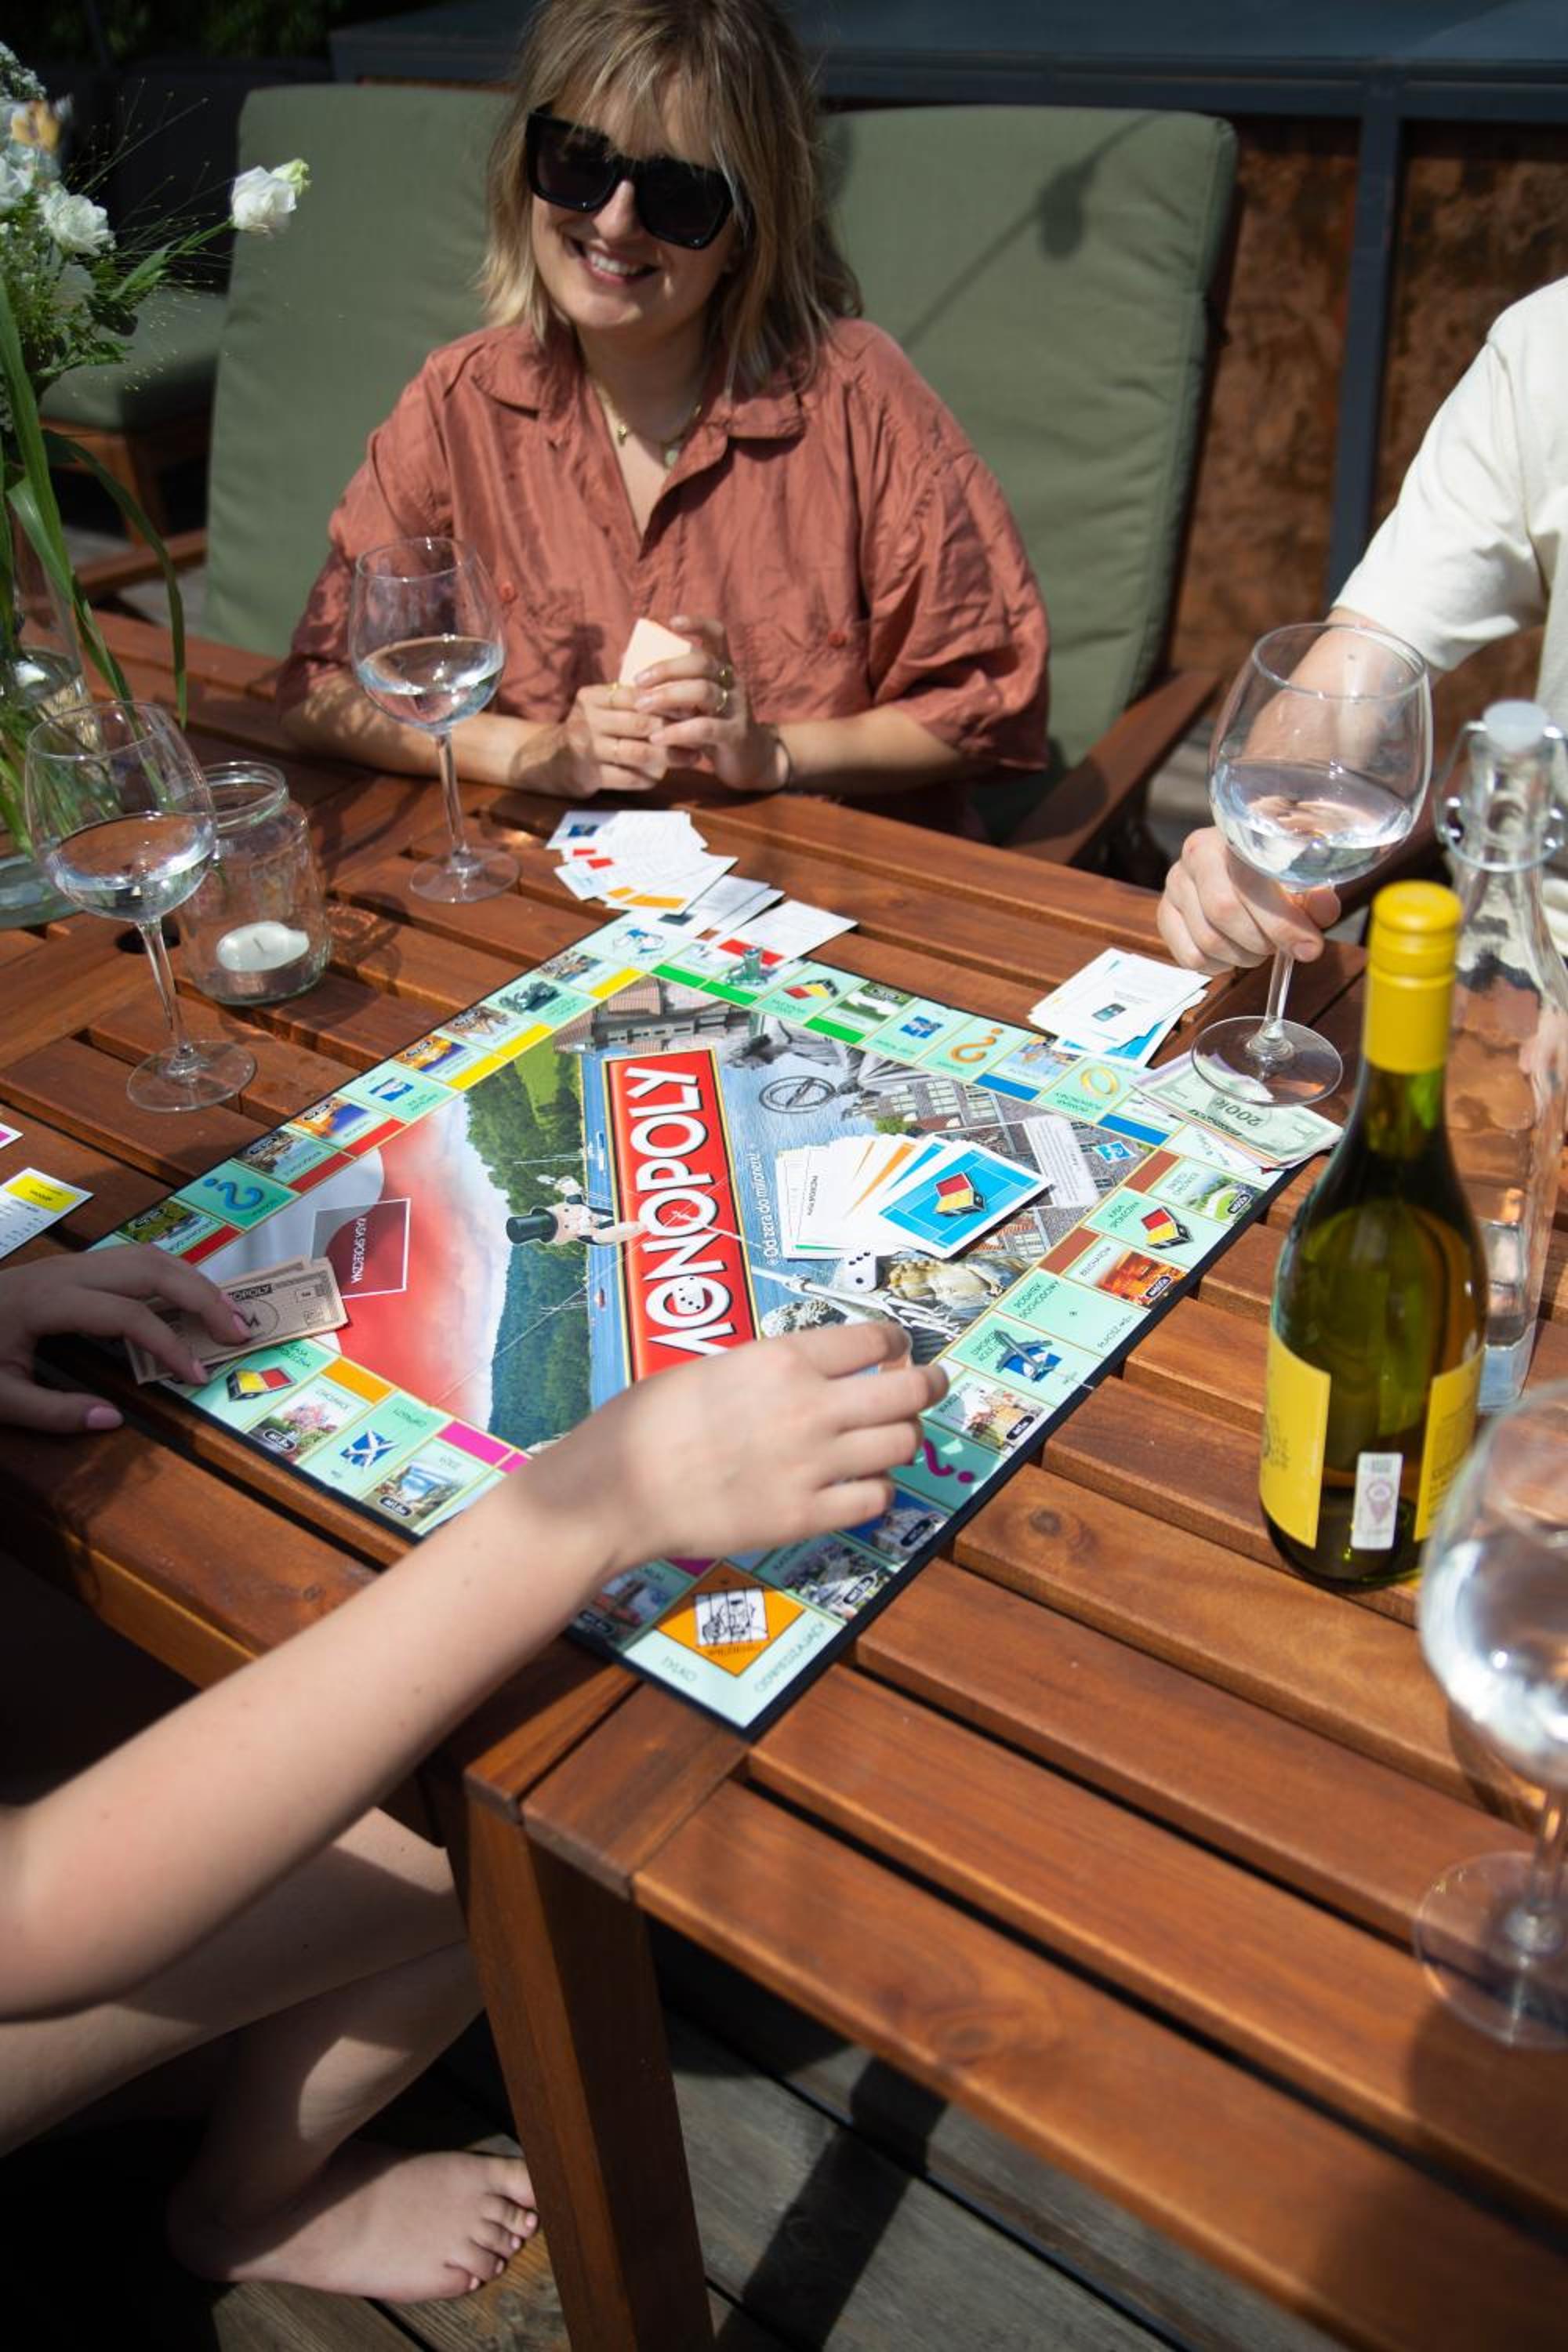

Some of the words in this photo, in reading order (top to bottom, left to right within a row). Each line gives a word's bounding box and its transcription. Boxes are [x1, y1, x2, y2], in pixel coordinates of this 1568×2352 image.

[754, 1199, 770, 1213] do
[356, 1218, 366, 1238] KASA
[759, 1215, 775, 1236] zera
[762, 1240, 779, 1257] Od
[350, 1239, 365, 1283] SPOŁECZNA
[224, 1283, 272, 1303] OPOLY
[1013, 1283, 1043, 1307] PODATEK
[1018, 1281, 1061, 1317] DOCHODOWY
